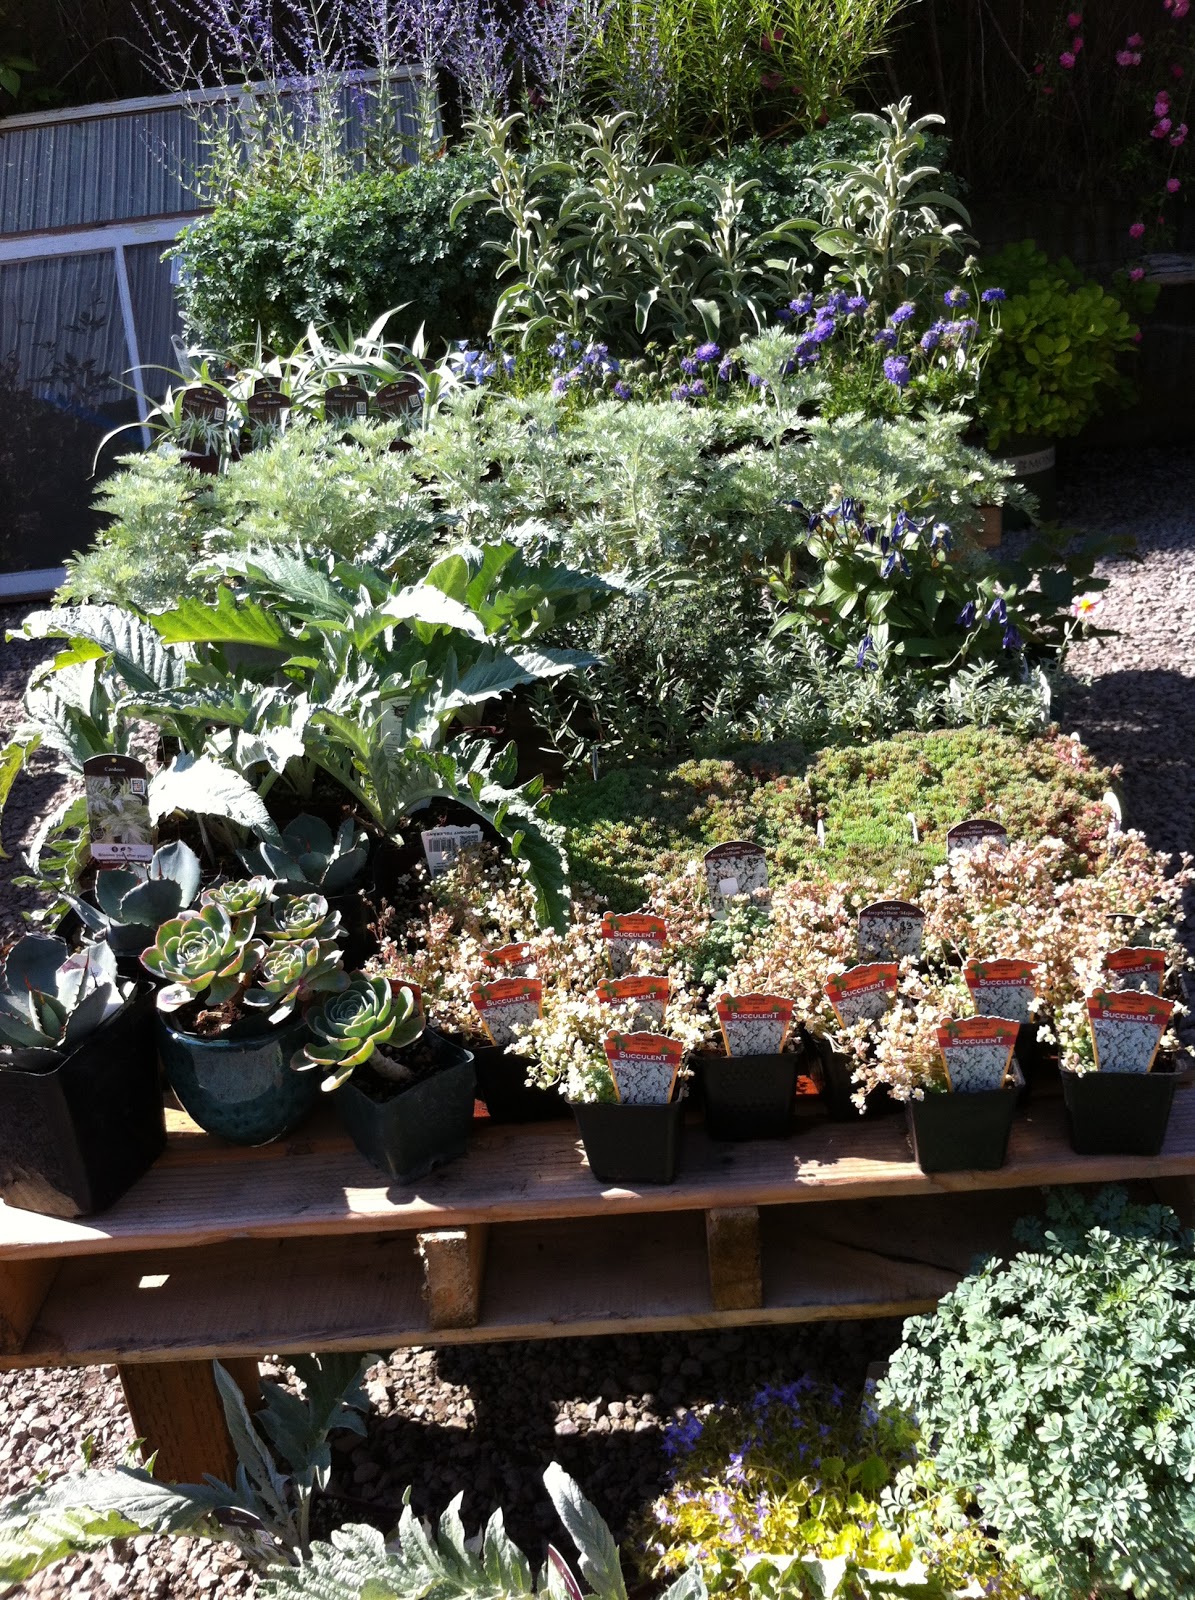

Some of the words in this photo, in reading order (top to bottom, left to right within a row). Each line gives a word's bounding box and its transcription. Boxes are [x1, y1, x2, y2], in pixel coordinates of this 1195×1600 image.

[613, 930, 657, 938] SUCCULENT
[979, 977, 1028, 986] SUCCULENT
[841, 979, 886, 998] SUCCULENT
[486, 993, 530, 1007] SUCCULENT
[1102, 1010, 1155, 1022] SUCCULENT
[952, 1036, 1003, 1045] SUCCULENT
[619, 1051, 668, 1061] SUCCULENT
